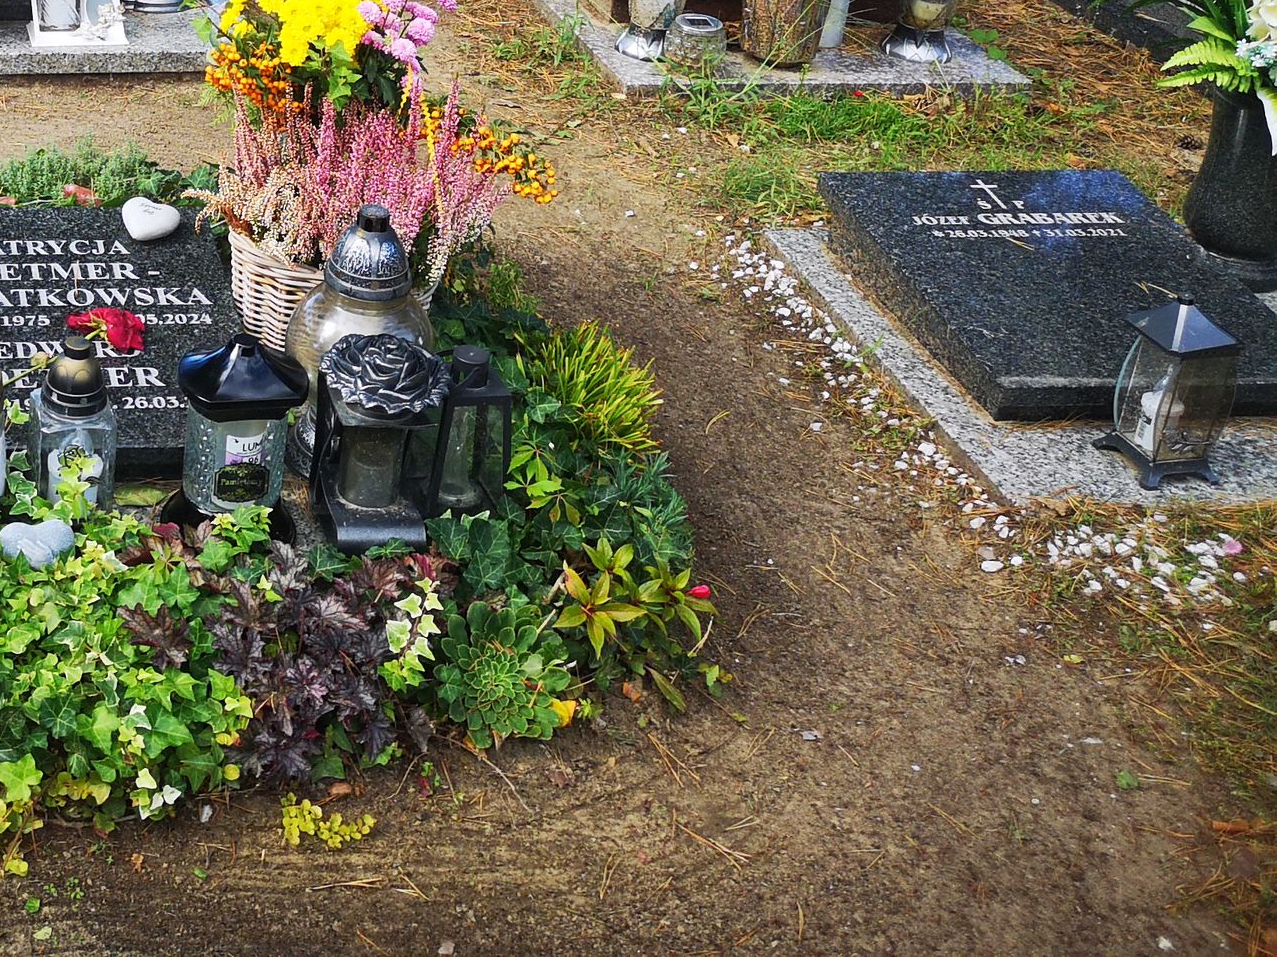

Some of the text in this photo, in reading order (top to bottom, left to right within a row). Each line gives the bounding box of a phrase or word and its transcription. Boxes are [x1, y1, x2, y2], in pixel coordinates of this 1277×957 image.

[1011, 200, 1026, 210] P
[912, 212, 1126, 226] JÓZEF GRABAREK
